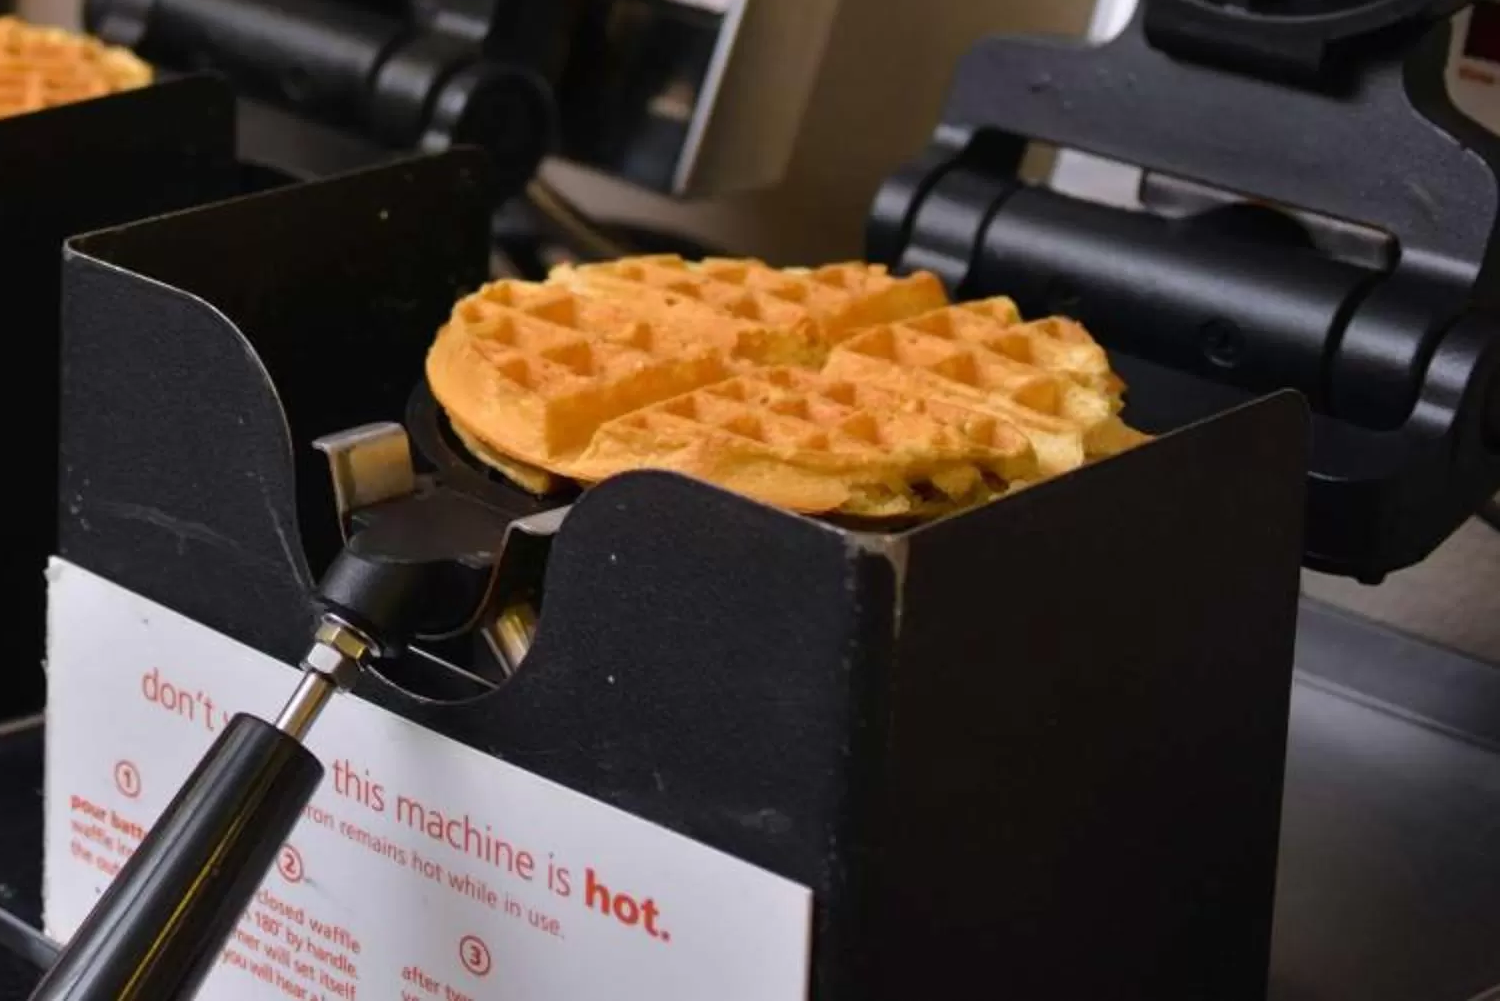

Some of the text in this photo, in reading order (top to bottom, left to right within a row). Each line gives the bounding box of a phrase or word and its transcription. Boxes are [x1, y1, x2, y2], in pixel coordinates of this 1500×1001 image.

[142, 666, 671, 943] don't this machine is hot.
[340, 820, 408, 867] remains
[411, 850, 443, 883] hot
[447, 869, 498, 911] while
[503, 891, 522, 919] in
[528, 907, 565, 941] use.
[286, 927, 304, 953] by
[307, 936, 360, 980] handle.
[308, 917, 361, 955] waffle
[264, 944, 290, 968] will
[319, 970, 358, 1001] itself
[400, 965, 439, 995] after
